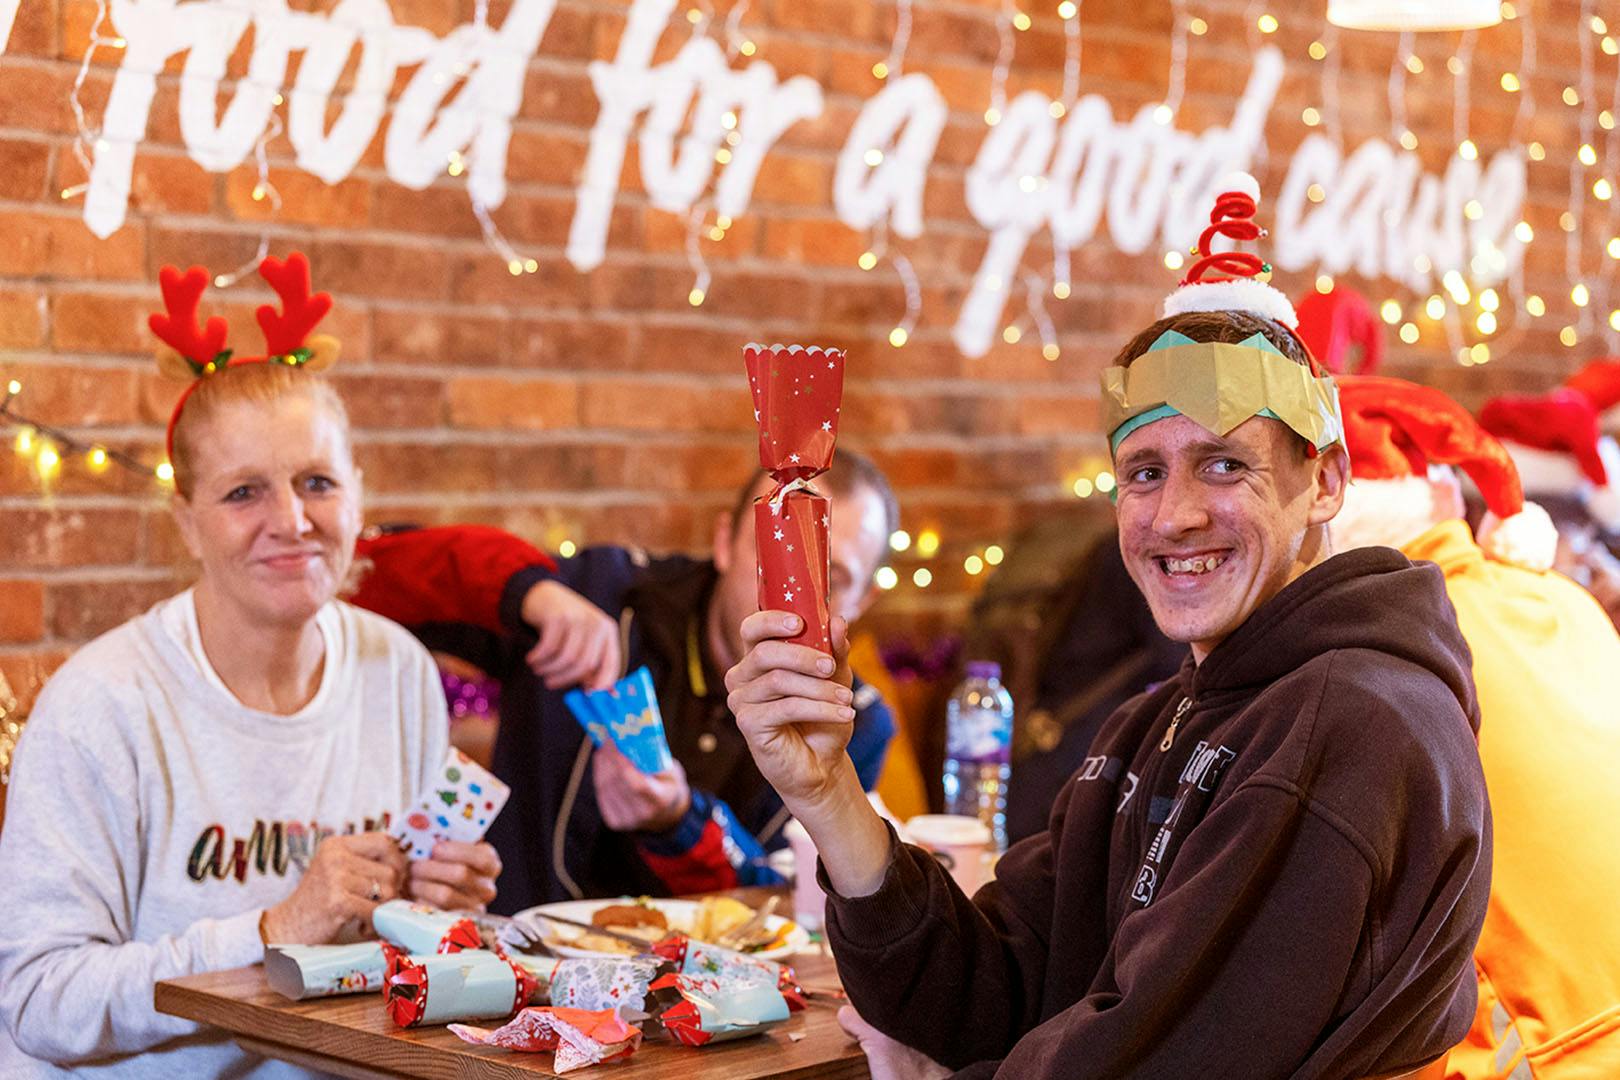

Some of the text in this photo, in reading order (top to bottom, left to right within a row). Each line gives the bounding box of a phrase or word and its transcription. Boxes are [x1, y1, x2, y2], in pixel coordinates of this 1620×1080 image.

[565, 0, 825, 273] for
[832, 72, 948, 240] a
[952, 45, 1286, 358] good
